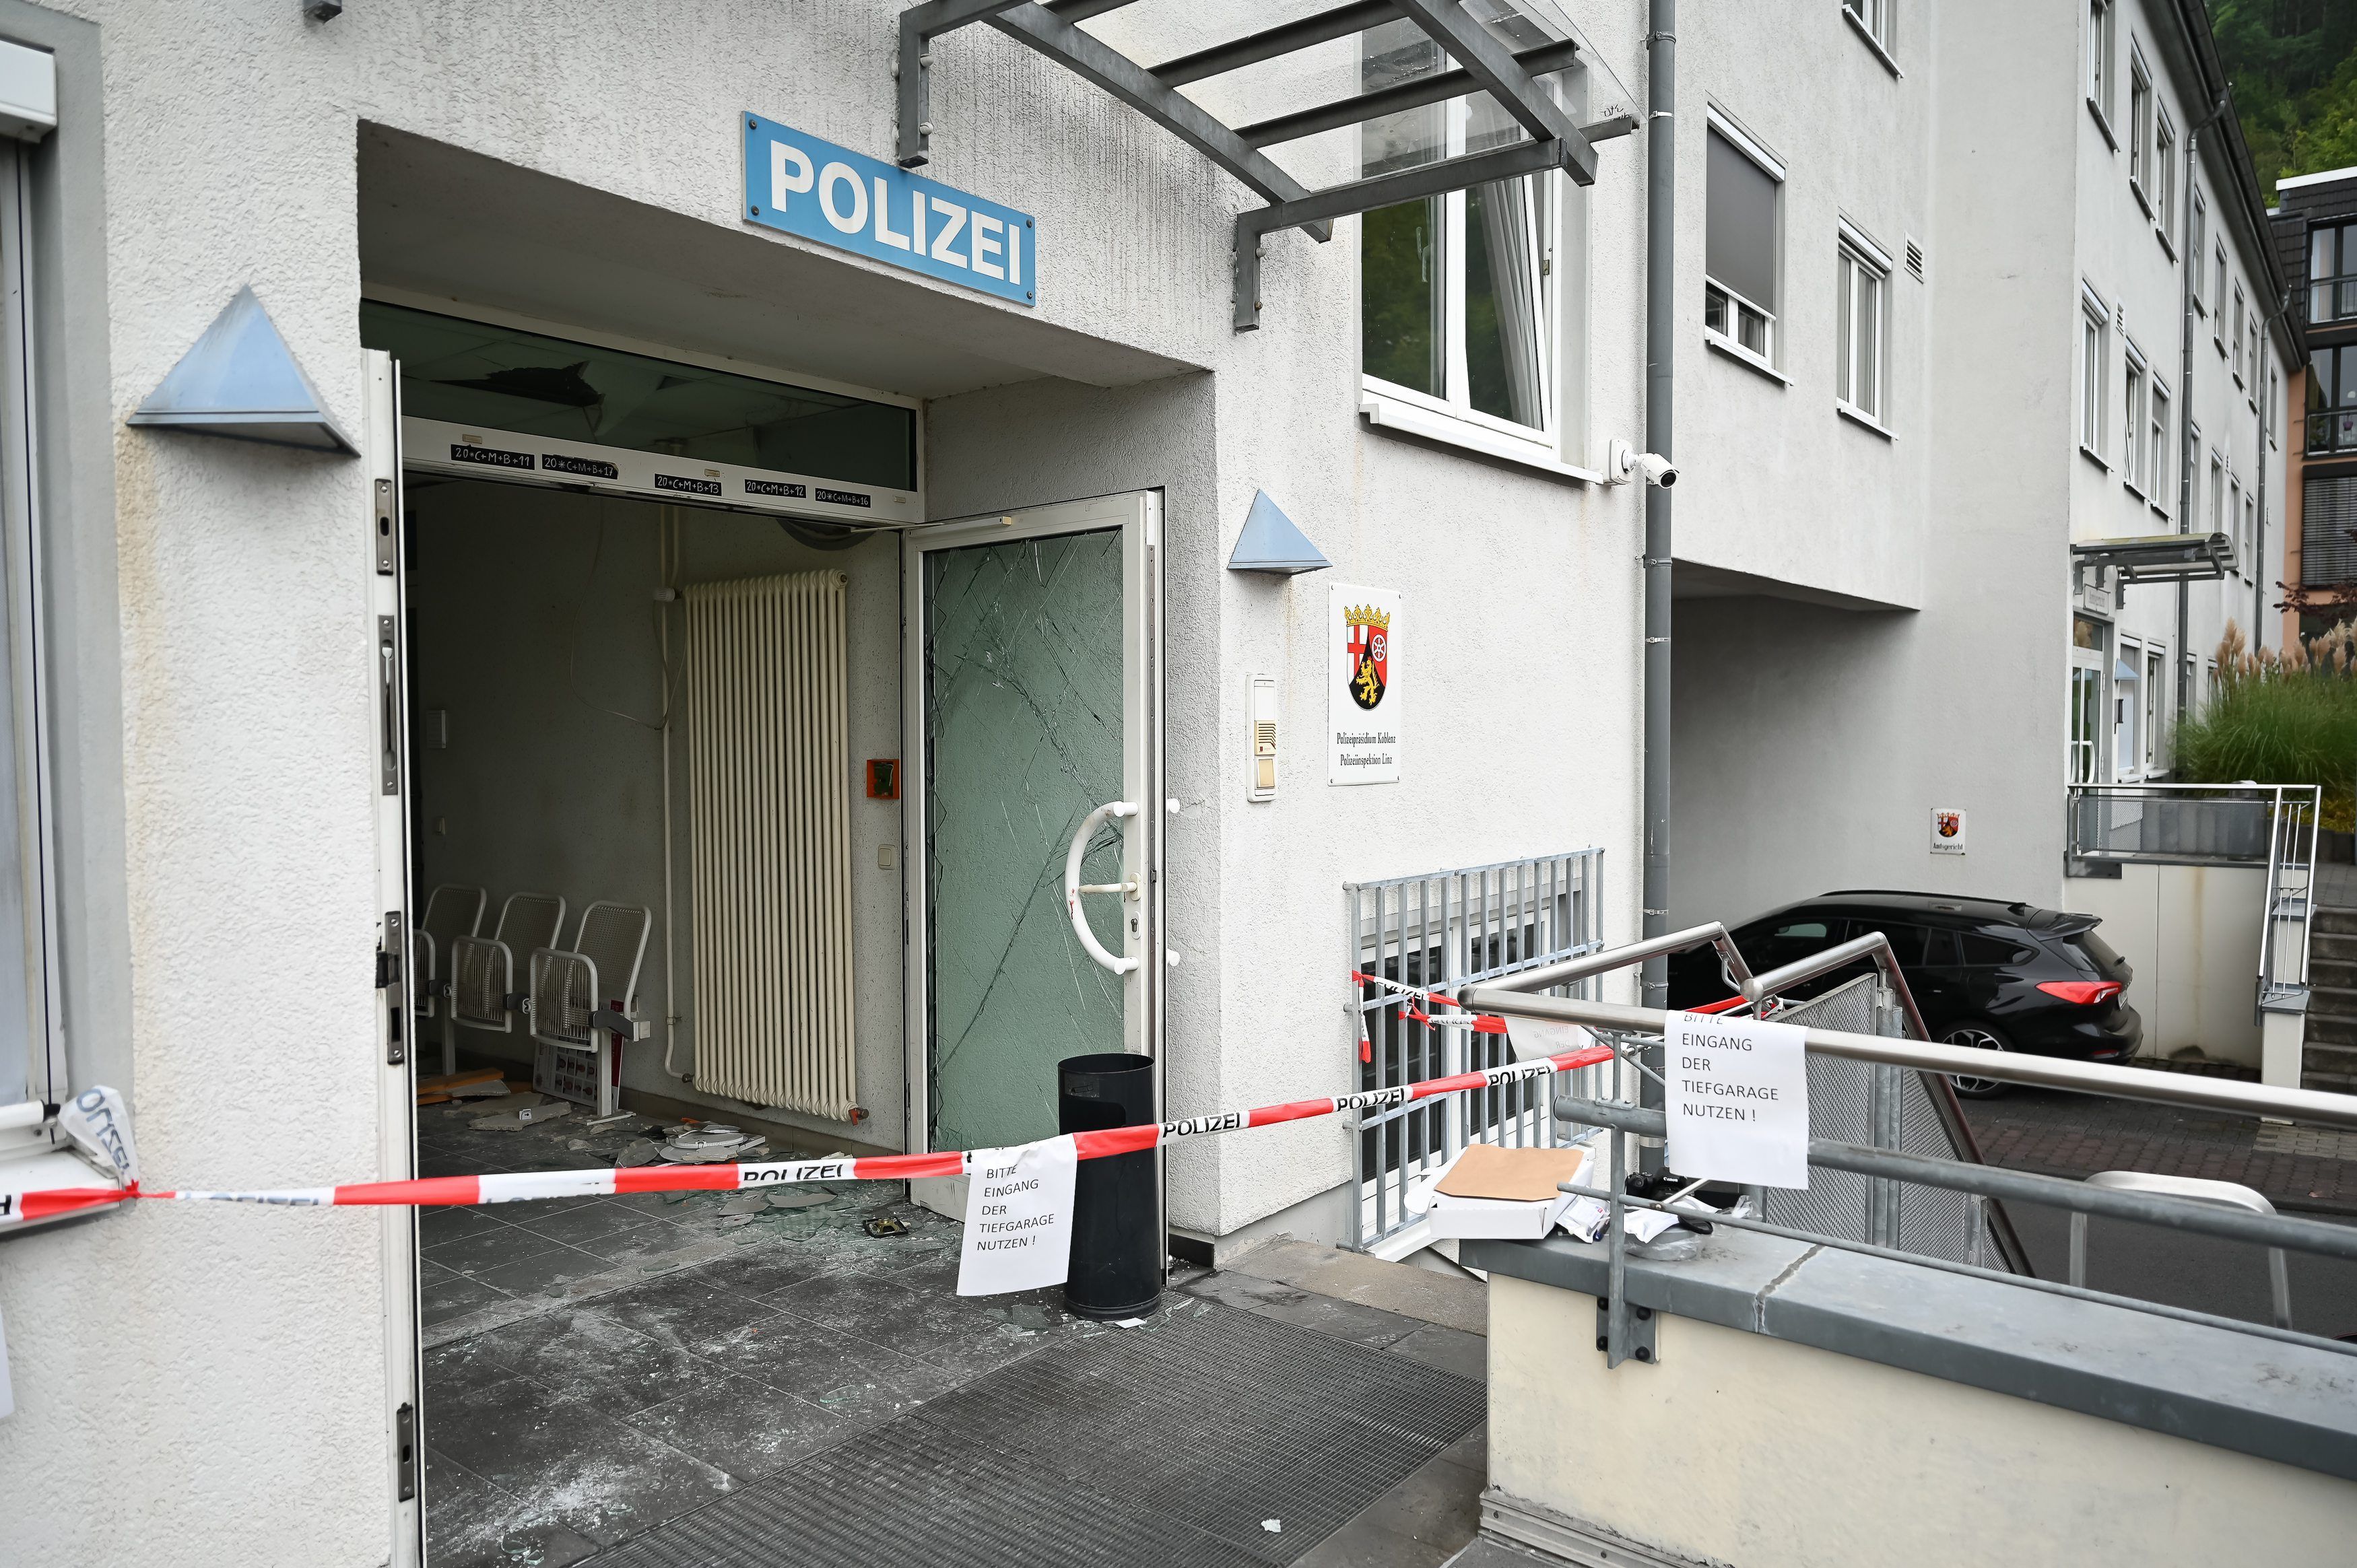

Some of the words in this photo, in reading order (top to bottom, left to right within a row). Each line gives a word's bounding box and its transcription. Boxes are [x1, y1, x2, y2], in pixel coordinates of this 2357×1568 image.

[770, 139, 1020, 285] POLIZEI
[1337, 732, 1376, 747] Polizeipräsidium
[1378, 732, 1396, 744] Koblenz
[1340, 753, 1381, 768] Polizeiinspektion
[1382, 753, 1392, 764] Linz
[1682, 1033, 1752, 1051] EINGANG
[1682, 1057, 1711, 1071] DER
[1682, 1080, 1779, 1100] TIEFGARAGE
[1336, 1088, 1404, 1112] POLIZEI
[1684, 1103, 1745, 1121] NUTZEN
[1162, 1112, 1240, 1138] POLIZEI
[987, 1164, 1018, 1178] BITTE
[984, 1180, 1038, 1197] EINGANG
[982, 1205, 1007, 1215] DER
[979, 1214, 1055, 1233] TIEFGARAGE
[977, 1237, 1028, 1251] NUTZEN
